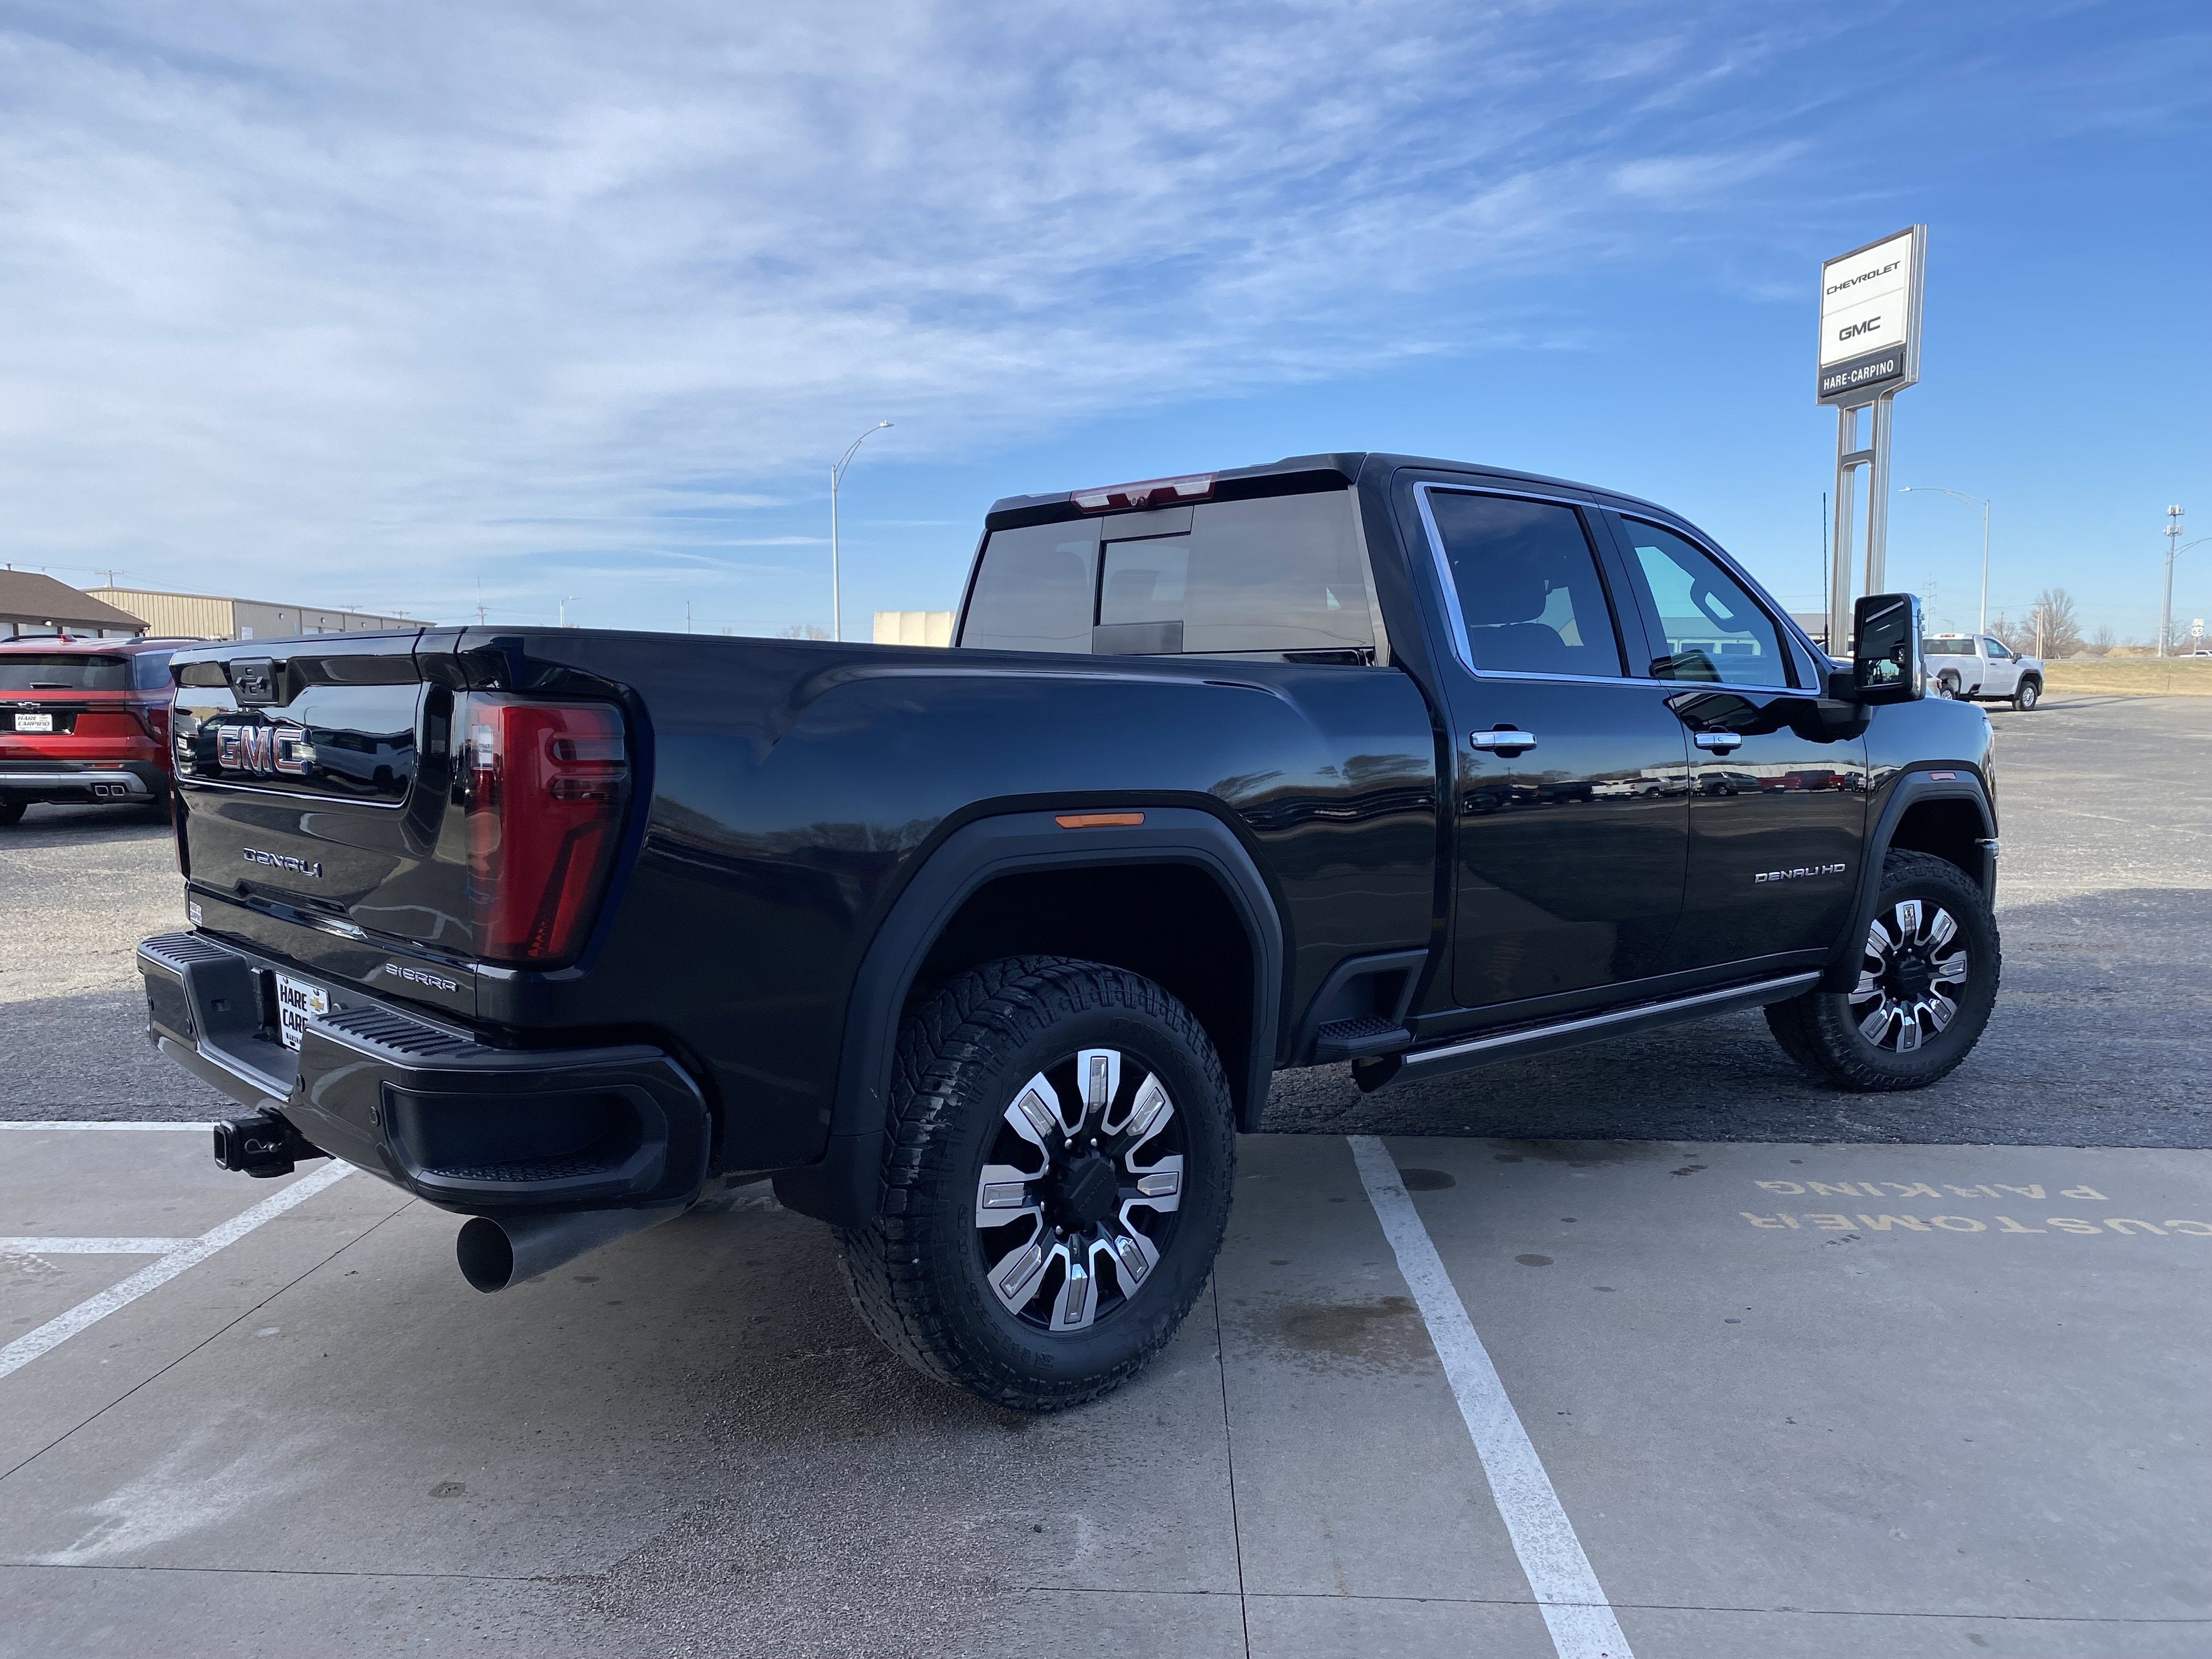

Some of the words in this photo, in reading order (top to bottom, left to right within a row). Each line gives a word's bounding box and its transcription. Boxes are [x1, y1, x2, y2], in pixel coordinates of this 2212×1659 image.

[1827, 261, 1901, 295] CHEVROLET
[1839, 315, 1881, 341] GMC
[1823, 359, 1894, 391] HARE-CARPINO
[217, 725, 314, 776] GMC
[244, 847, 323, 878] DENALI
[1754, 866, 1819, 883] DENALI
[1821, 863, 1846, 874] HD
[386, 962, 460, 992] SIERRA
[280, 984, 308, 1013] HARE
[1755, 1181, 2110, 1200] PARKING
[1739, 1211, 2212, 1236] CUSTOMER
